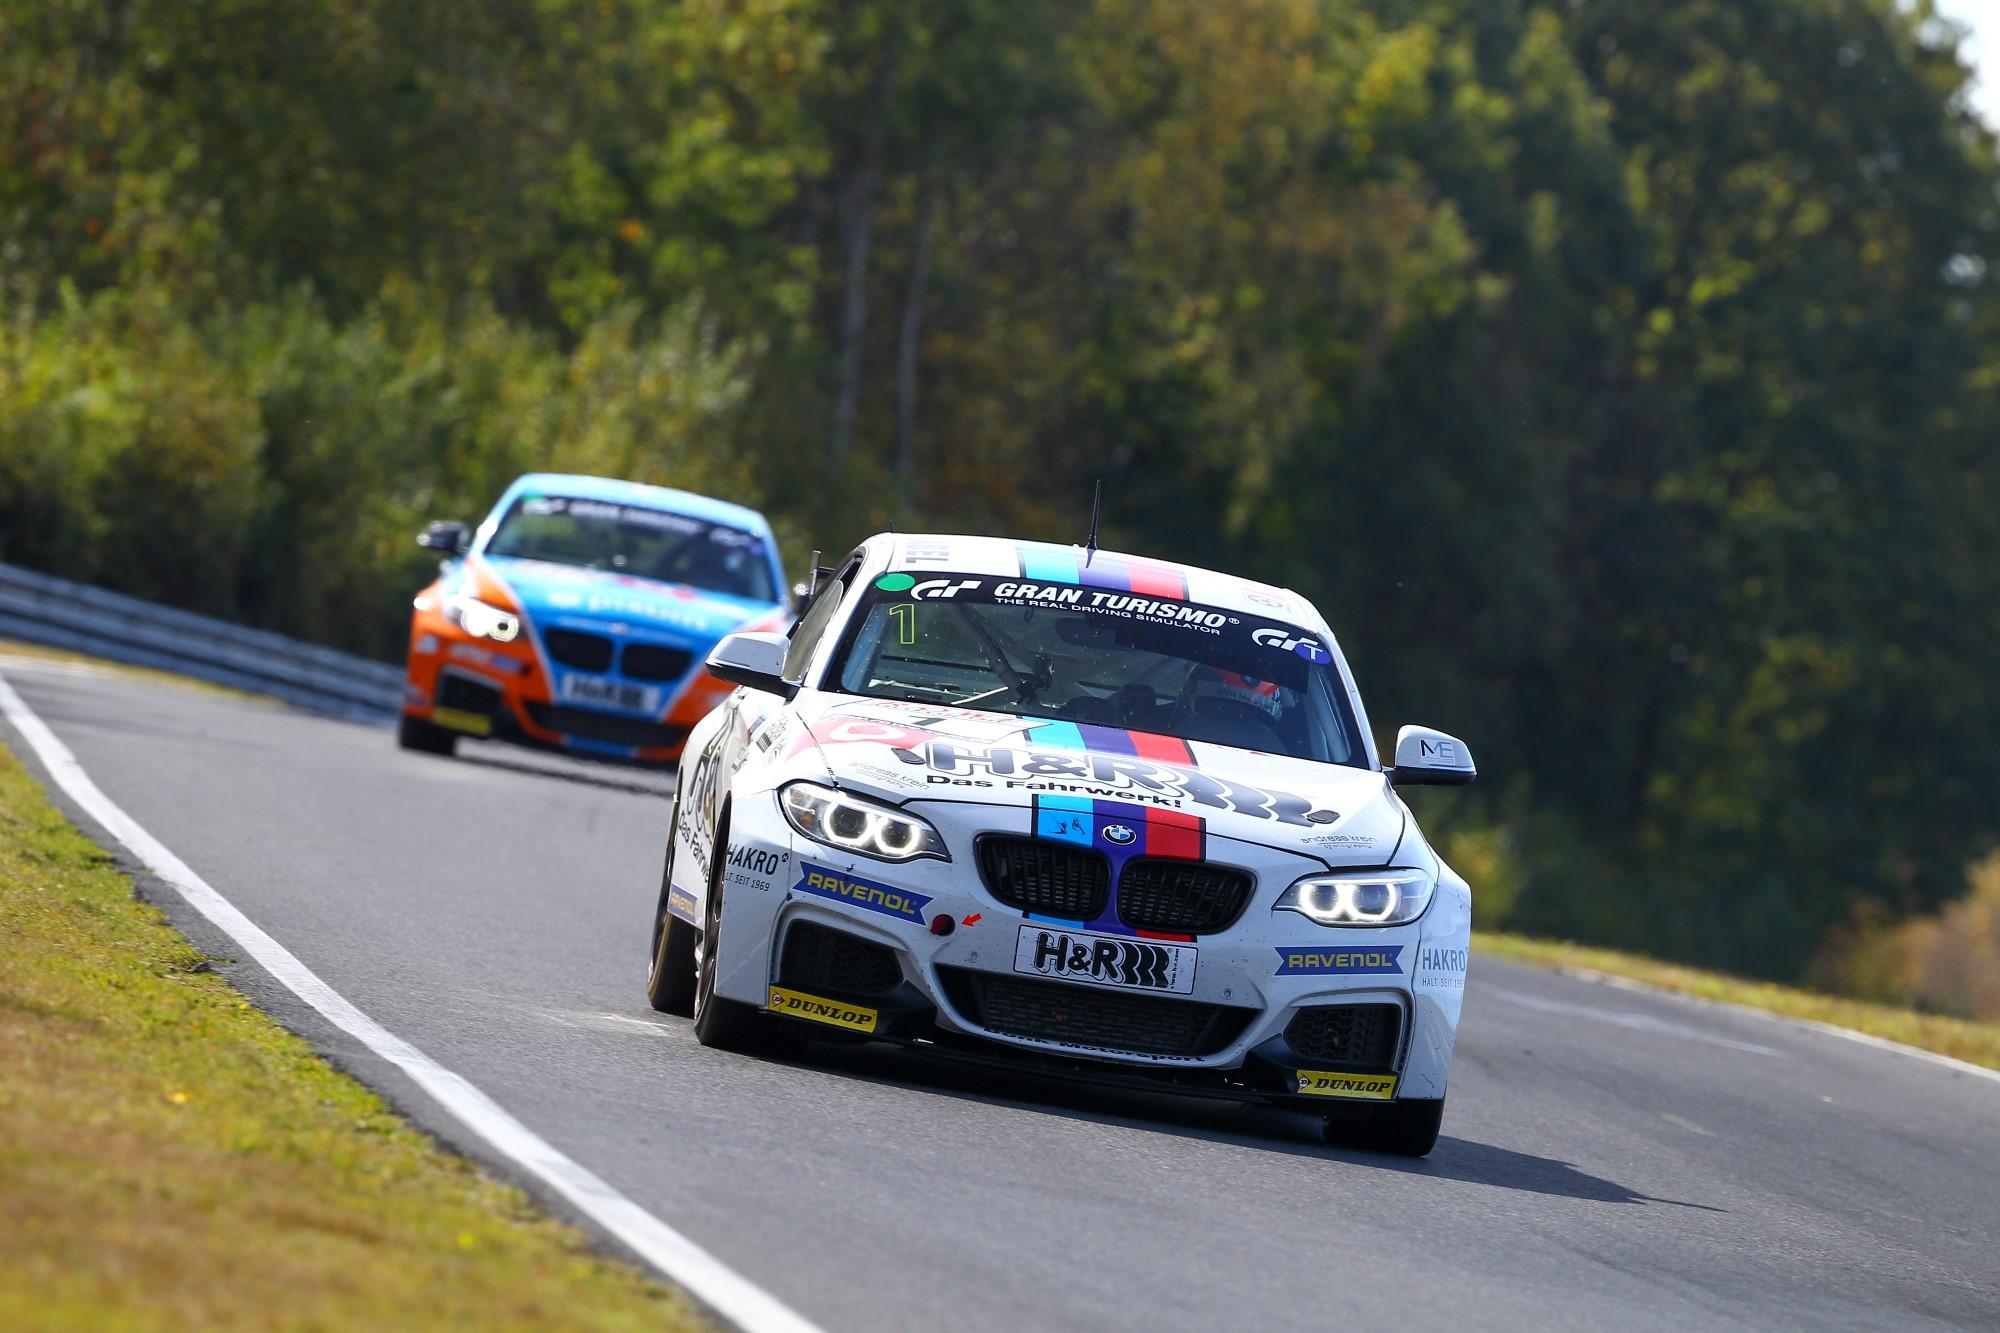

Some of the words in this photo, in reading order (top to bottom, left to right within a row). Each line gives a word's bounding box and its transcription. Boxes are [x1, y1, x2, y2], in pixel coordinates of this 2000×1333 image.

[993, 582, 1083, 604] GRAN
[889, 603, 915, 645] 1
[994, 597, 1025, 606] THE
[1028, 600, 1068, 610] REAL
[1071, 604, 1132, 618] DRIVING
[1135, 614, 1221, 636] SIMULATOR
[926, 774, 993, 789] Das
[1006, 781, 1182, 809] Fahrwerk!
[727, 843, 779, 875] HAKRO
[734, 874, 751, 886] SEIT
[751, 879, 770, 892] 1969
[807, 872, 914, 915] RAVENOL
[1288, 953, 1393, 968] RAVENOL
[1422, 948, 1466, 972] HAKRO
[786, 997, 873, 1025] DUNLOP
[1314, 1077, 1392, 1093] DUNLOP
